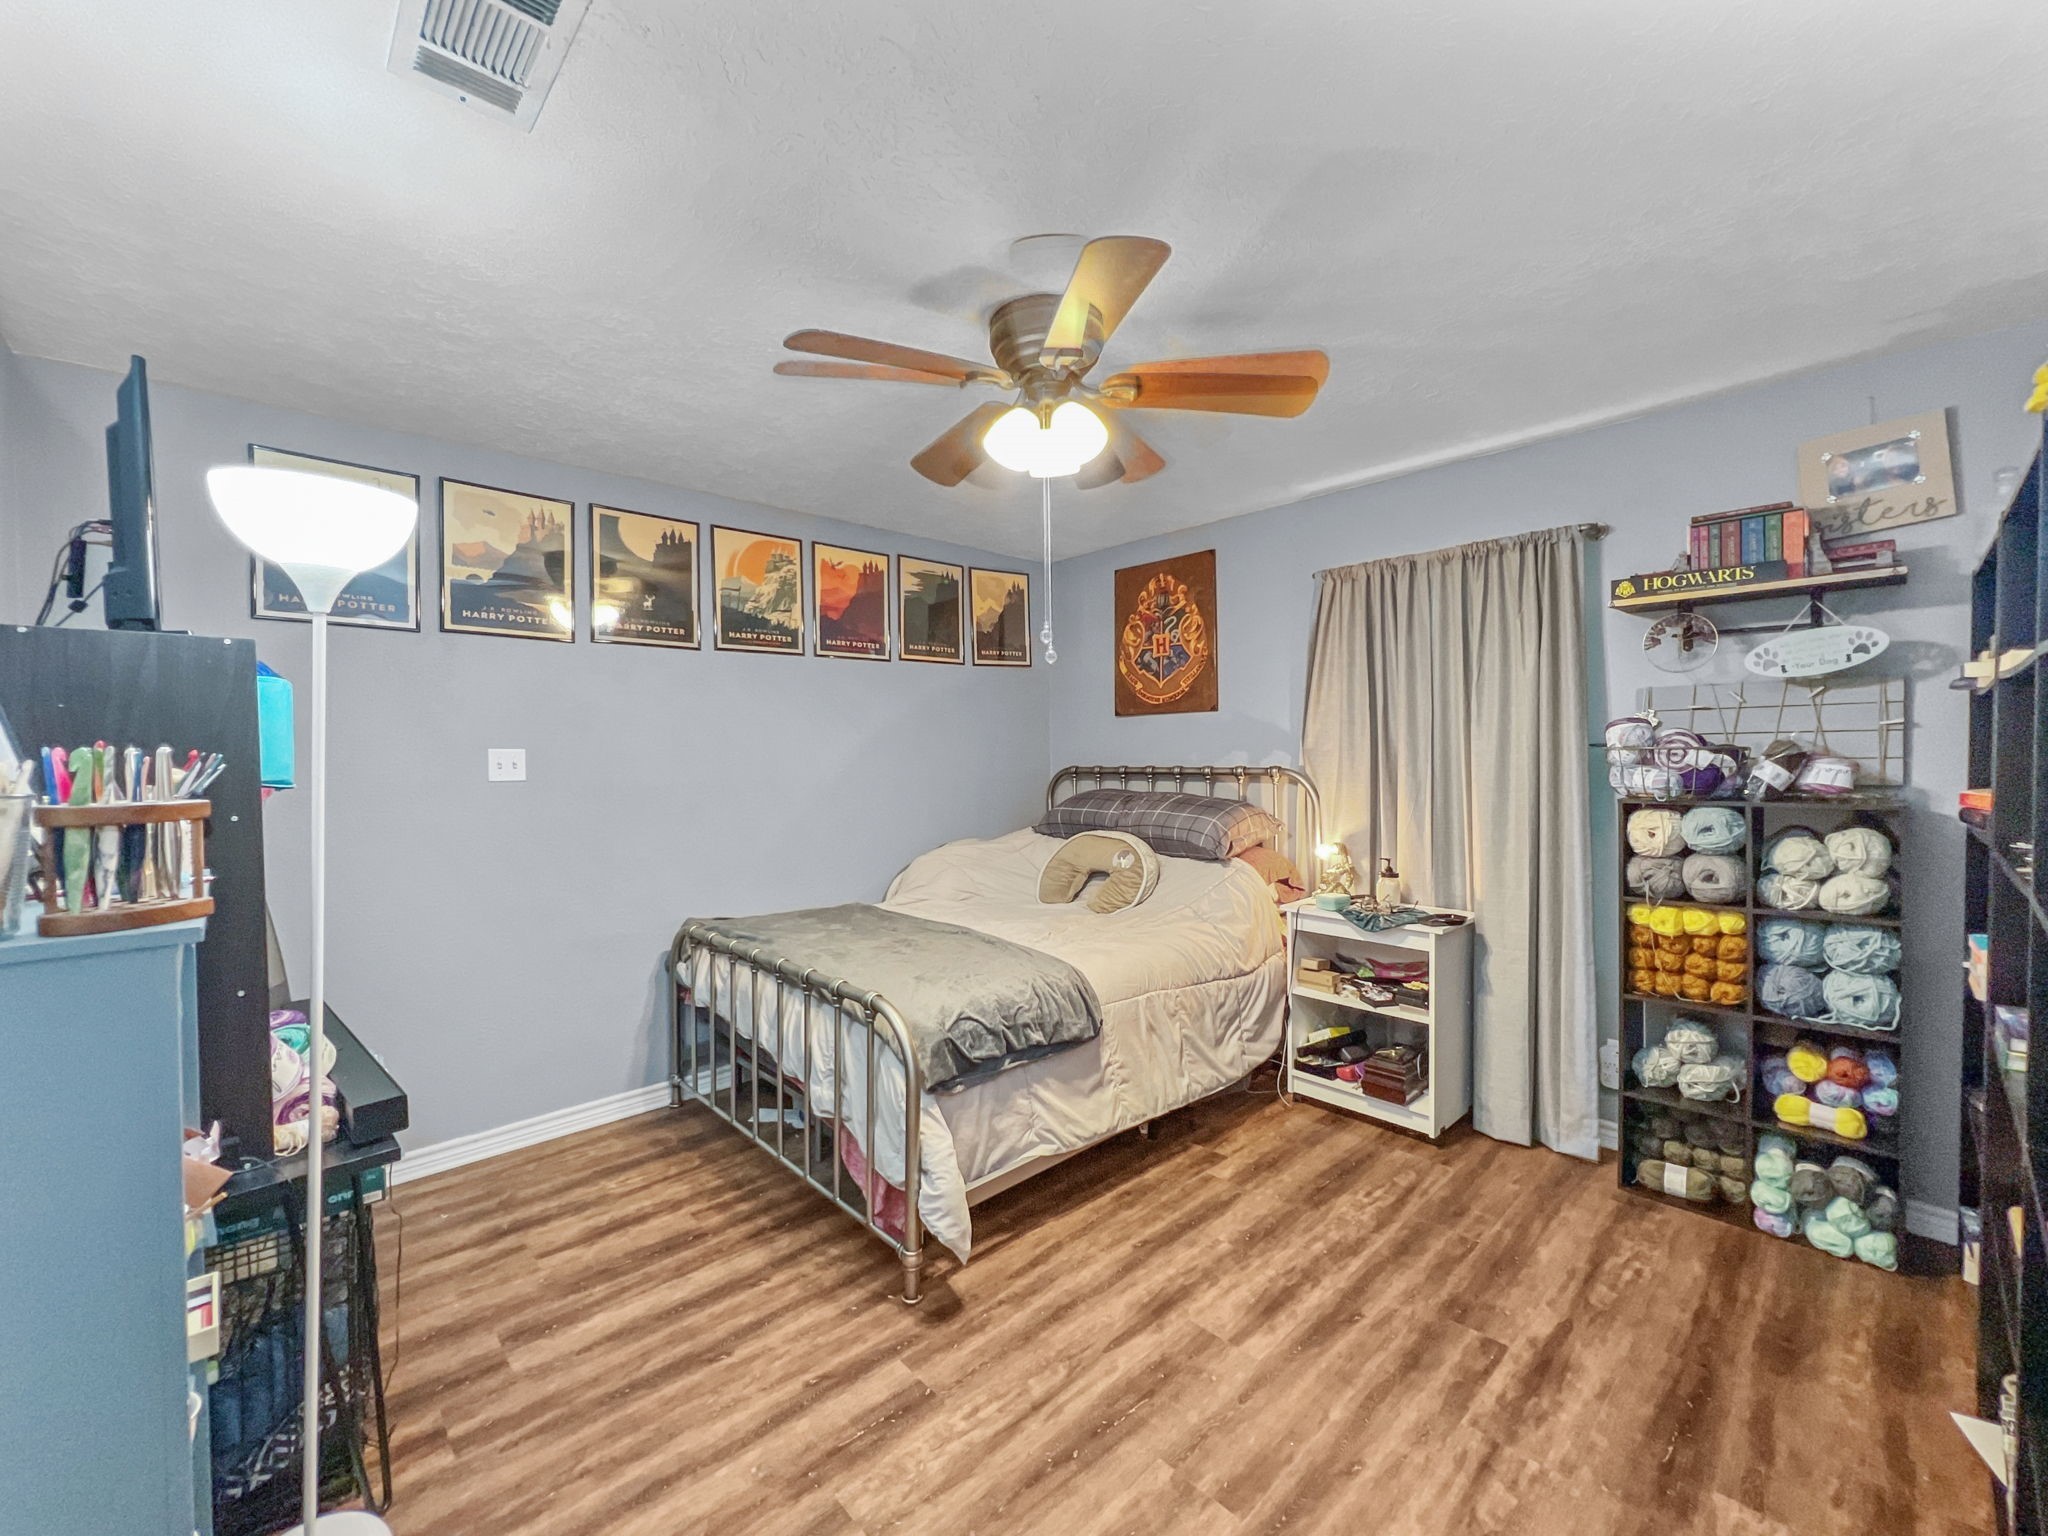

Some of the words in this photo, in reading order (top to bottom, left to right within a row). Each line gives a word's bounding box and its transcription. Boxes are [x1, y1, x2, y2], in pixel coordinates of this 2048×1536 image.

[1643, 566, 1756, 591] HOGWARTS
[338, 601, 396, 612] POTTER
[462, 610, 504, 621] HARRY
[509, 614, 549, 625] POTTE
[646, 625, 685, 636] POTTER
[729, 631, 758, 640] HARRY
[759, 634, 792, 643] POTTER
[826, 639, 851, 647] HARRY
[852, 641, 880, 649] POTTER
[1156, 639, 1168, 654] H
[931, 646, 955, 654] POTTER
